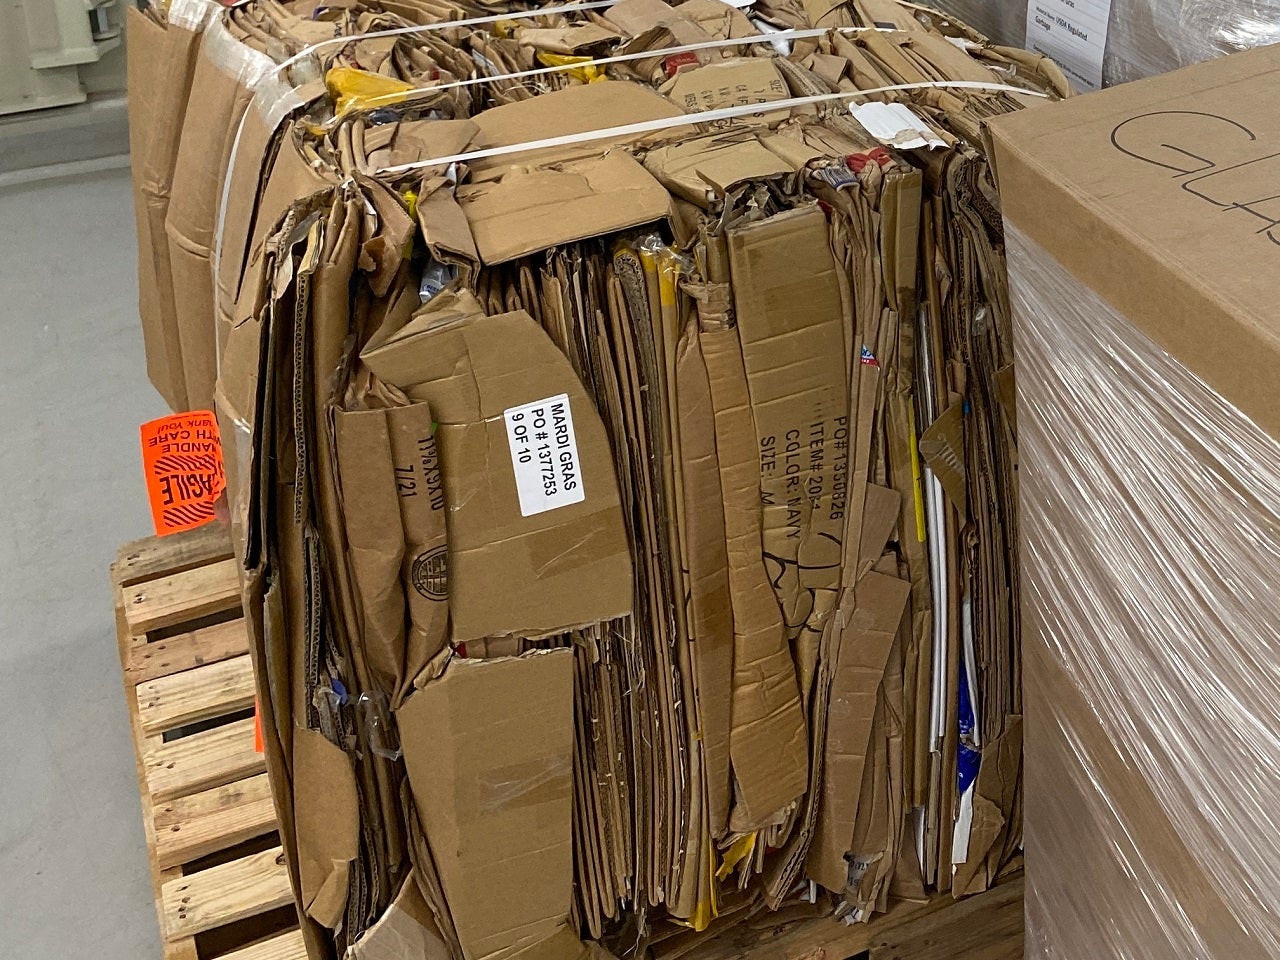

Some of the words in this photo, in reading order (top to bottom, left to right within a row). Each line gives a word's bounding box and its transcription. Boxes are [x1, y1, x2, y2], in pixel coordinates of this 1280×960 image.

[1068, 23, 1087, 41] Regulated
[512, 413, 524, 422] 9
[531, 408, 546, 428] PO
[551, 403, 570, 450] MARDI
[158, 422, 183, 434] You!
[514, 425, 528, 445] OF
[536, 431, 547, 441] #
[149, 430, 190, 447] CARE
[518, 450, 530, 463] 10
[761, 436, 775, 477] SIZE:
[785, 429, 800, 494] COLOR:
[538, 443, 557, 496] 1377253
[558, 452, 576, 491] GRAS
[160, 474, 213, 505] AGILE
[396, 465, 417, 498] 7/21
[760, 492, 773, 505] M
[787, 498, 800, 539] NAVY
